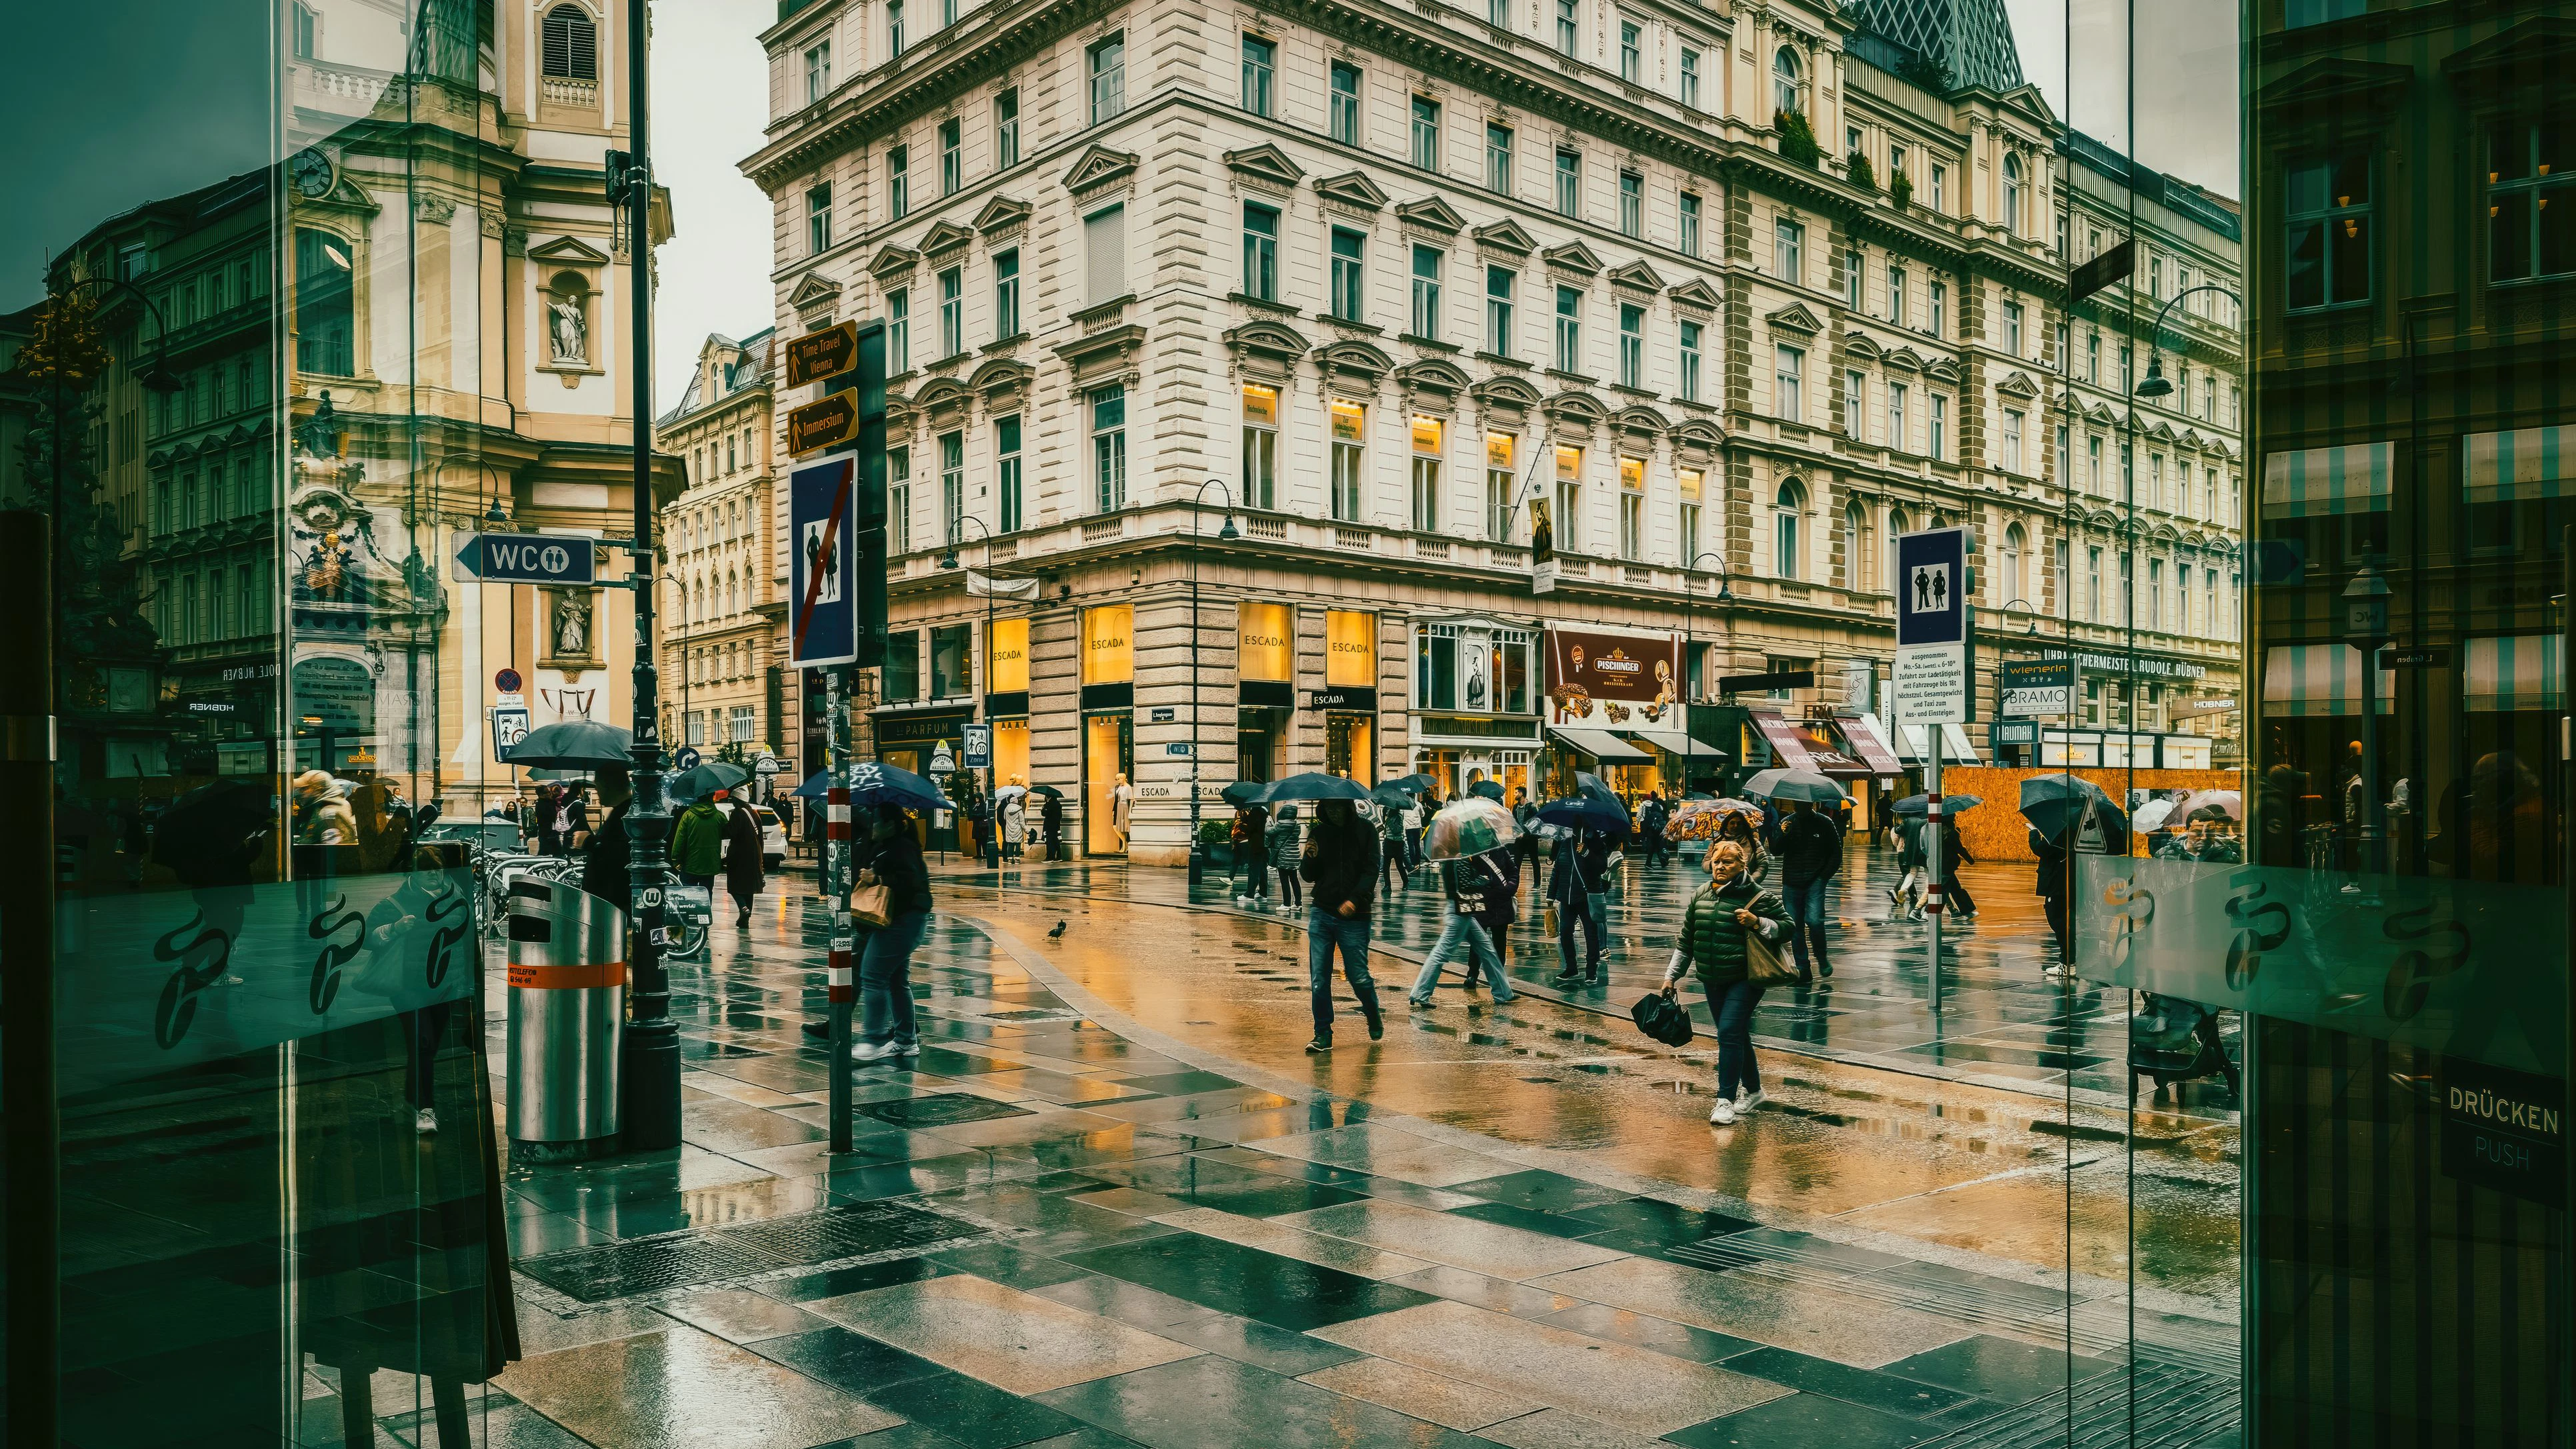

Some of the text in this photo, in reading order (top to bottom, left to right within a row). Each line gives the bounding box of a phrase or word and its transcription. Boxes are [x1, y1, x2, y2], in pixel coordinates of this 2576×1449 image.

[803, 334, 840, 359] Time Travel
[810, 359, 833, 375] Vienna
[803, 411, 844, 436] Immersium
[491, 543, 538, 571] WC
[1092, 638, 1124, 649] ESCADA
[1245, 635, 1285, 647] ESCADA
[1333, 642, 1369, 653] ESCADA
[993, 650, 1021, 661] ESCADA
[1911, 652, 1947, 660] ausgenommen
[1597, 660, 1639, 671] PISCHINGER
[2010, 665, 2067, 674] wienerin
[2175, 661, 2206, 679] HÜBNER
[1928, 669, 1961, 677] Ladetätigkeit
[1845, 674, 1863, 701] FRICK
[1924, 689, 1962, 697] Gesamtgewicht
[1314, 695, 1344, 704] ESCADA
[2010, 689, 2067, 704] BRAMO
[2193, 699, 2235, 709] HÜBNER
[1929, 709, 1955, 717] Einsteigen
[906, 723, 949, 735] PARFUM
[516, 734, 526, 743] 20
[1141, 788, 1170, 796] ESCADA
[1198, 787, 1225, 796] SCAD
[2450, 1086, 2557, 1134] DRÜCKEN
[2476, 1136, 2529, 1170] PUSH
